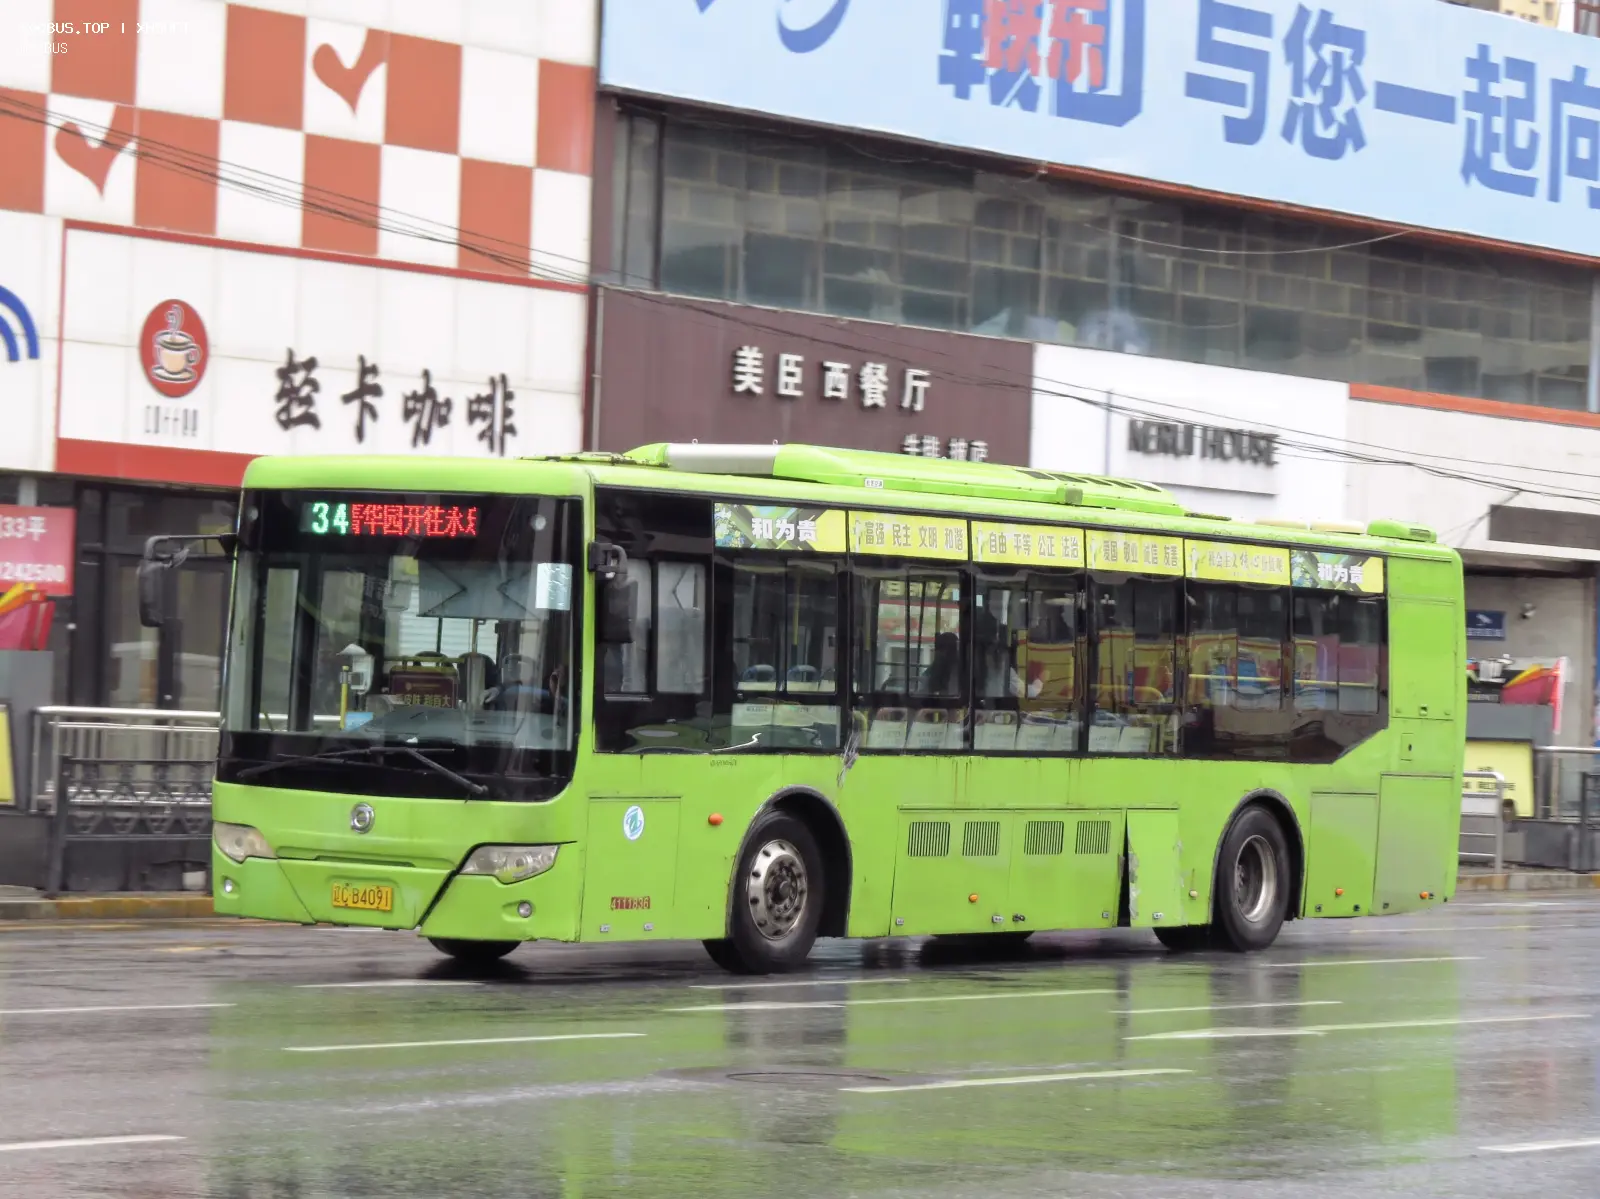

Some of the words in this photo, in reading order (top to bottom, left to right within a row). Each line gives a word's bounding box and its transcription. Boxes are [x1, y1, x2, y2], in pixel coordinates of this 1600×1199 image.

[732, 345, 932, 412] 美臣西餐厅
[312, 502, 350, 535] 34
[751, 517, 818, 543] 和为贵
[1317, 562, 1364, 584] 和为贵
